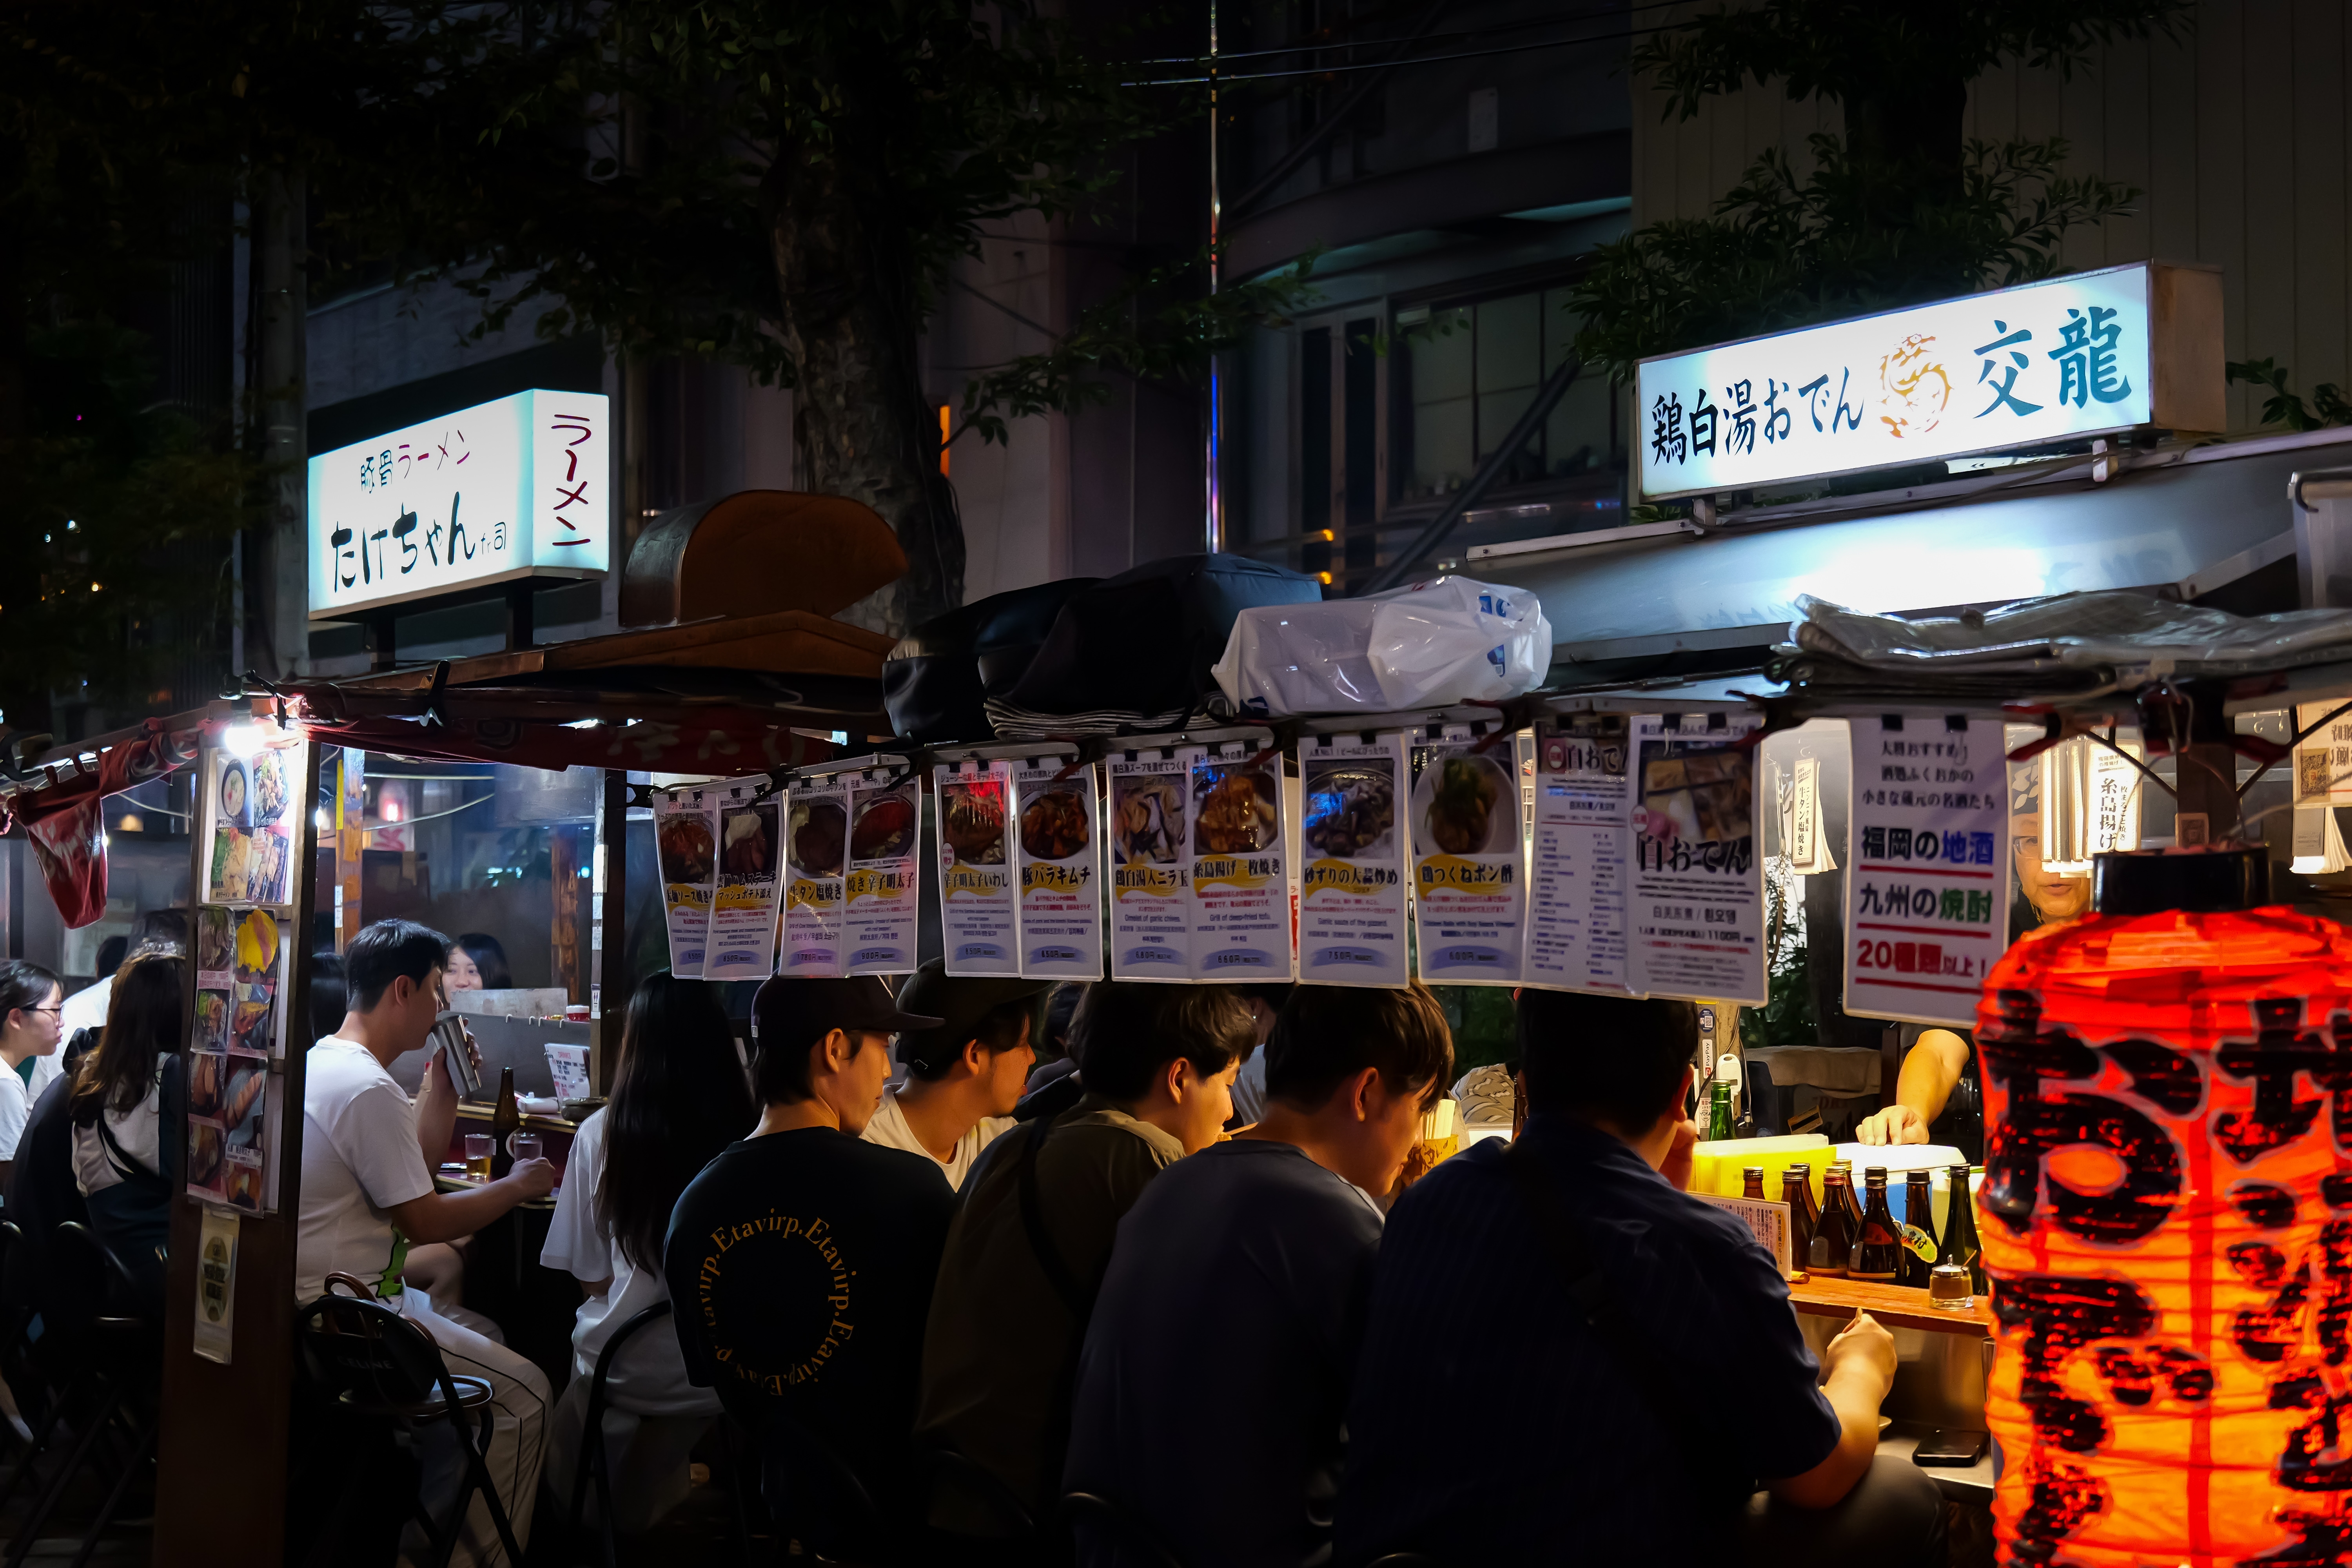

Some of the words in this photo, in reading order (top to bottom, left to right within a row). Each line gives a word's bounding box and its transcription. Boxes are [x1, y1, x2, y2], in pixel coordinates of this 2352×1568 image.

[1974, 306, 2132, 419] 交龍
[1651, 366, 1863, 466] 鶏白湯おでん
[360, 430, 470, 494] 豚骨ラーメン
[551, 414, 592, 546] ラーメン
[331, 491, 475, 593] たけちゃん
[2100, 778, 2117, 849] 糸島揚げ
[1639, 835, 1749, 876] 白おでん
[1861, 826, 1994, 866] 福岡の地酒
[789, 883, 841, 903] 牛タン塩焼き
[847, 871, 915, 893] 焼き辛子明太子
[944, 872, 1009, 888] 辛子明太子いわし
[1022, 865, 1091, 886] 豚バラキムチ
[1859, 882, 1993, 924] 九州の焼酎
[1135, 951, 1155, 960] 680円
[1218, 955, 1240, 964] 660円
[1328, 951, 1351, 960] 750円
